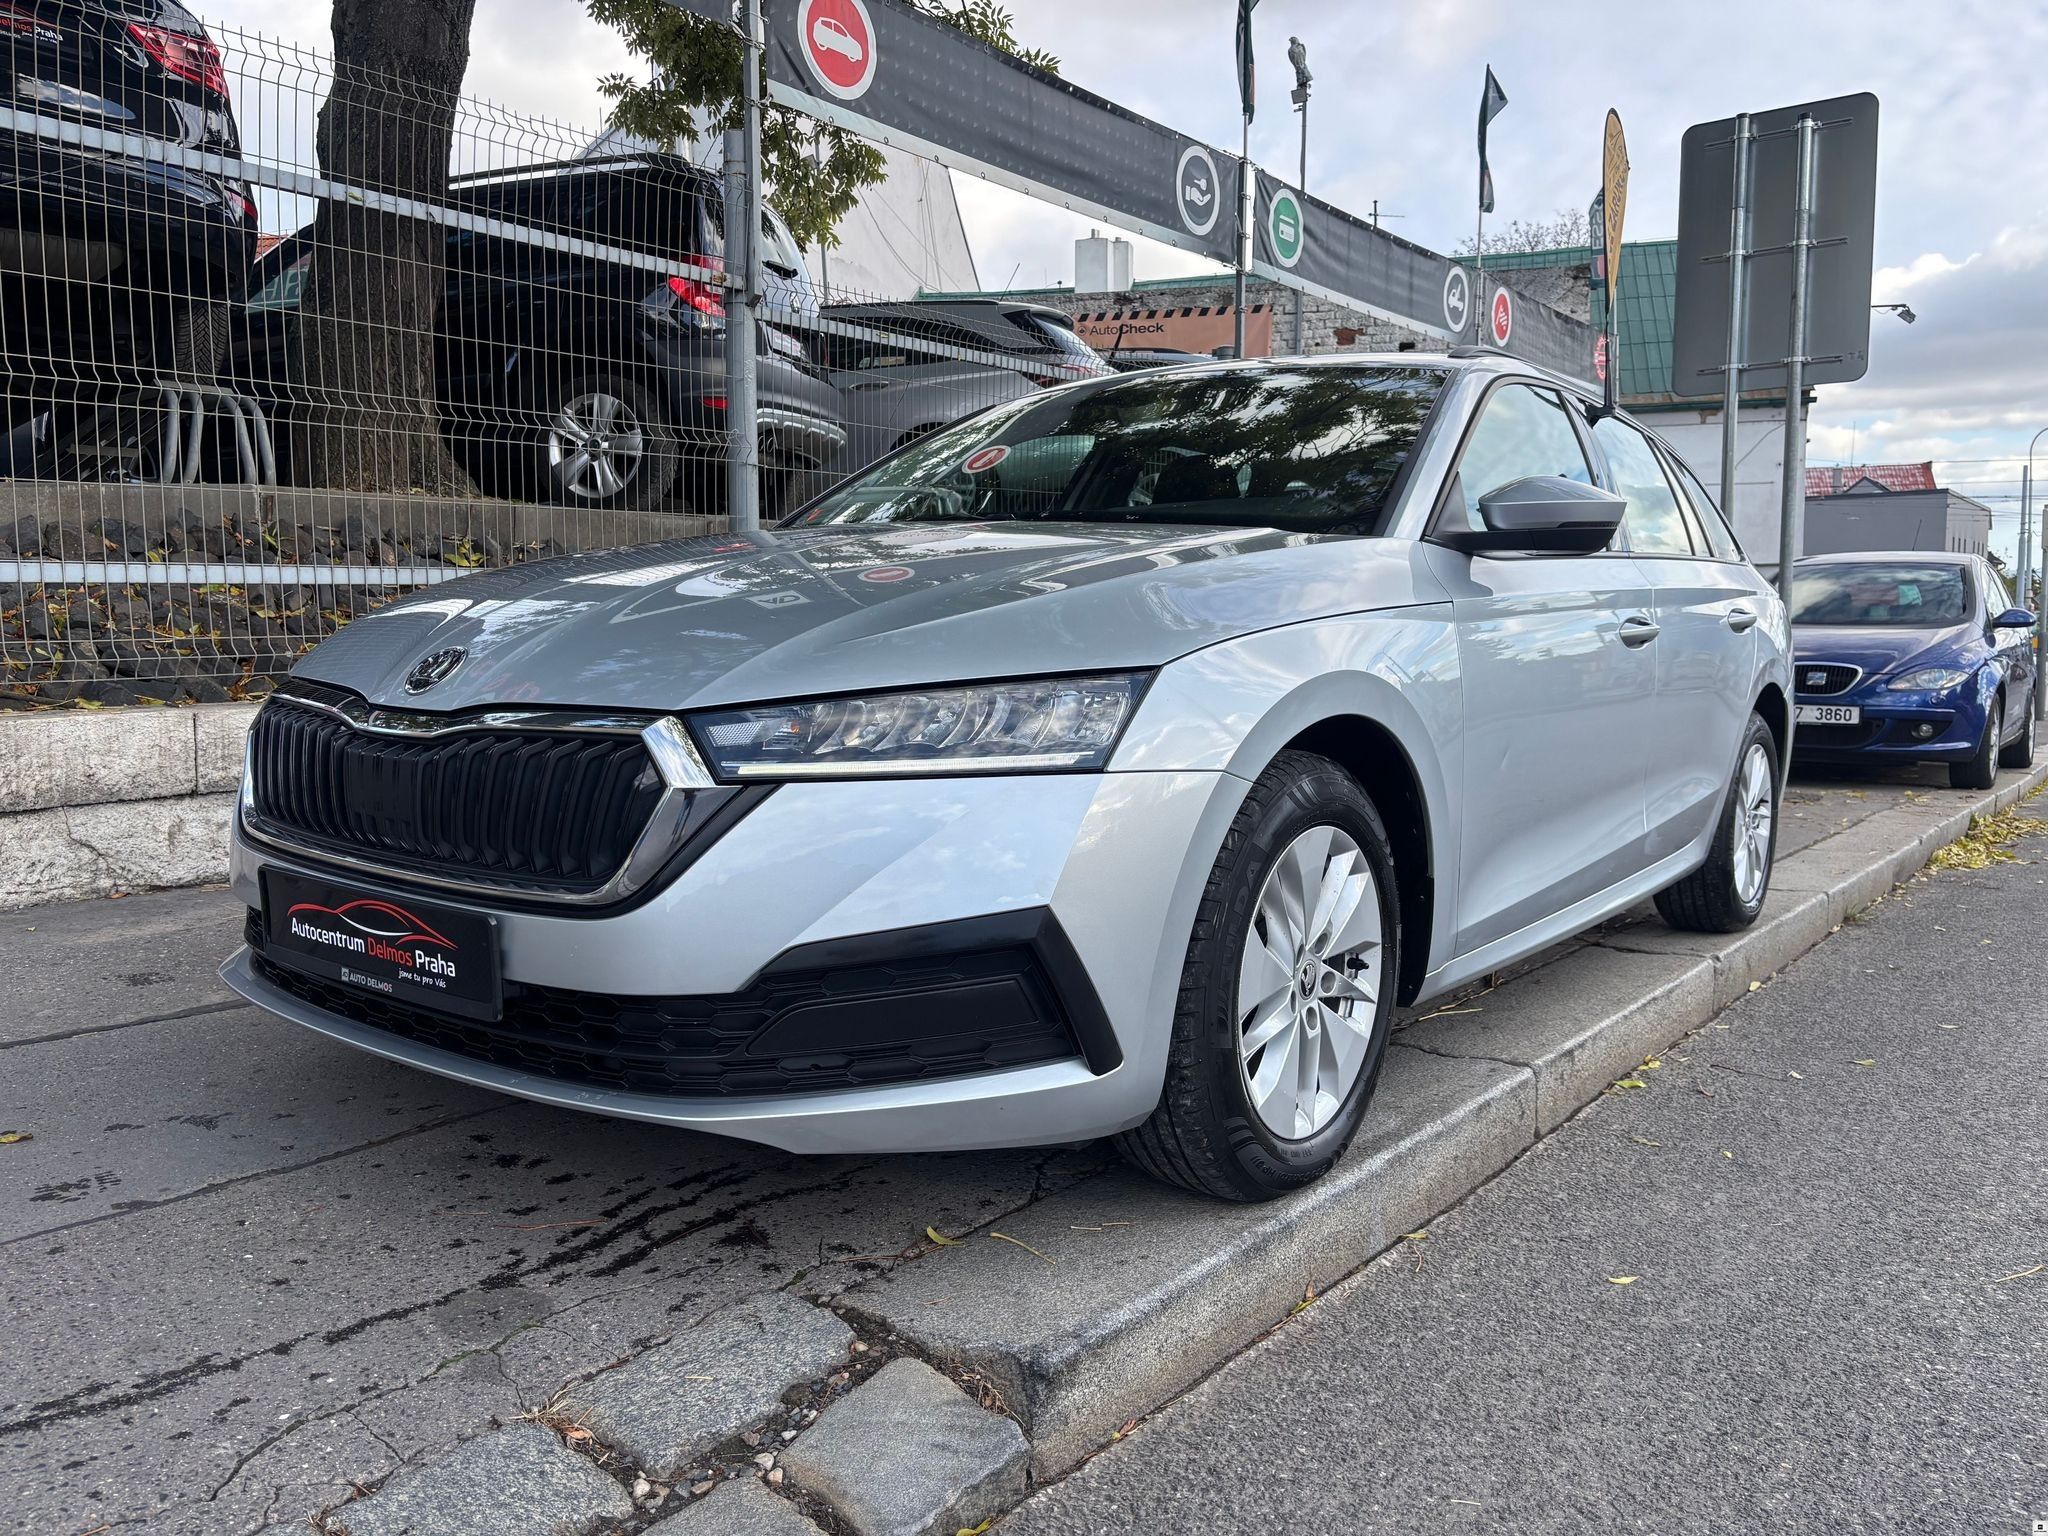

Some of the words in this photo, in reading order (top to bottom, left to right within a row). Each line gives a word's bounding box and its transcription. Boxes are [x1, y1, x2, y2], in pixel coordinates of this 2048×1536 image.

[0, 17, 32, 32] elmos
[35, 25, 63, 41] Praha
[1089, 322, 1164, 336] AutoCheck
[1815, 707, 1852, 722] 3860
[291, 917, 365, 954] Autocentrum
[367, 937, 413, 967] Delmos
[415, 950, 456, 977] Praha
[349, 972, 366, 984] AUTO
[367, 977, 393, 993] DELMOS
[398, 967, 412, 979] jsme
[413, 972, 421, 982] tu
[422, 976, 433, 986] pro
[434, 977, 447, 988] Vás
